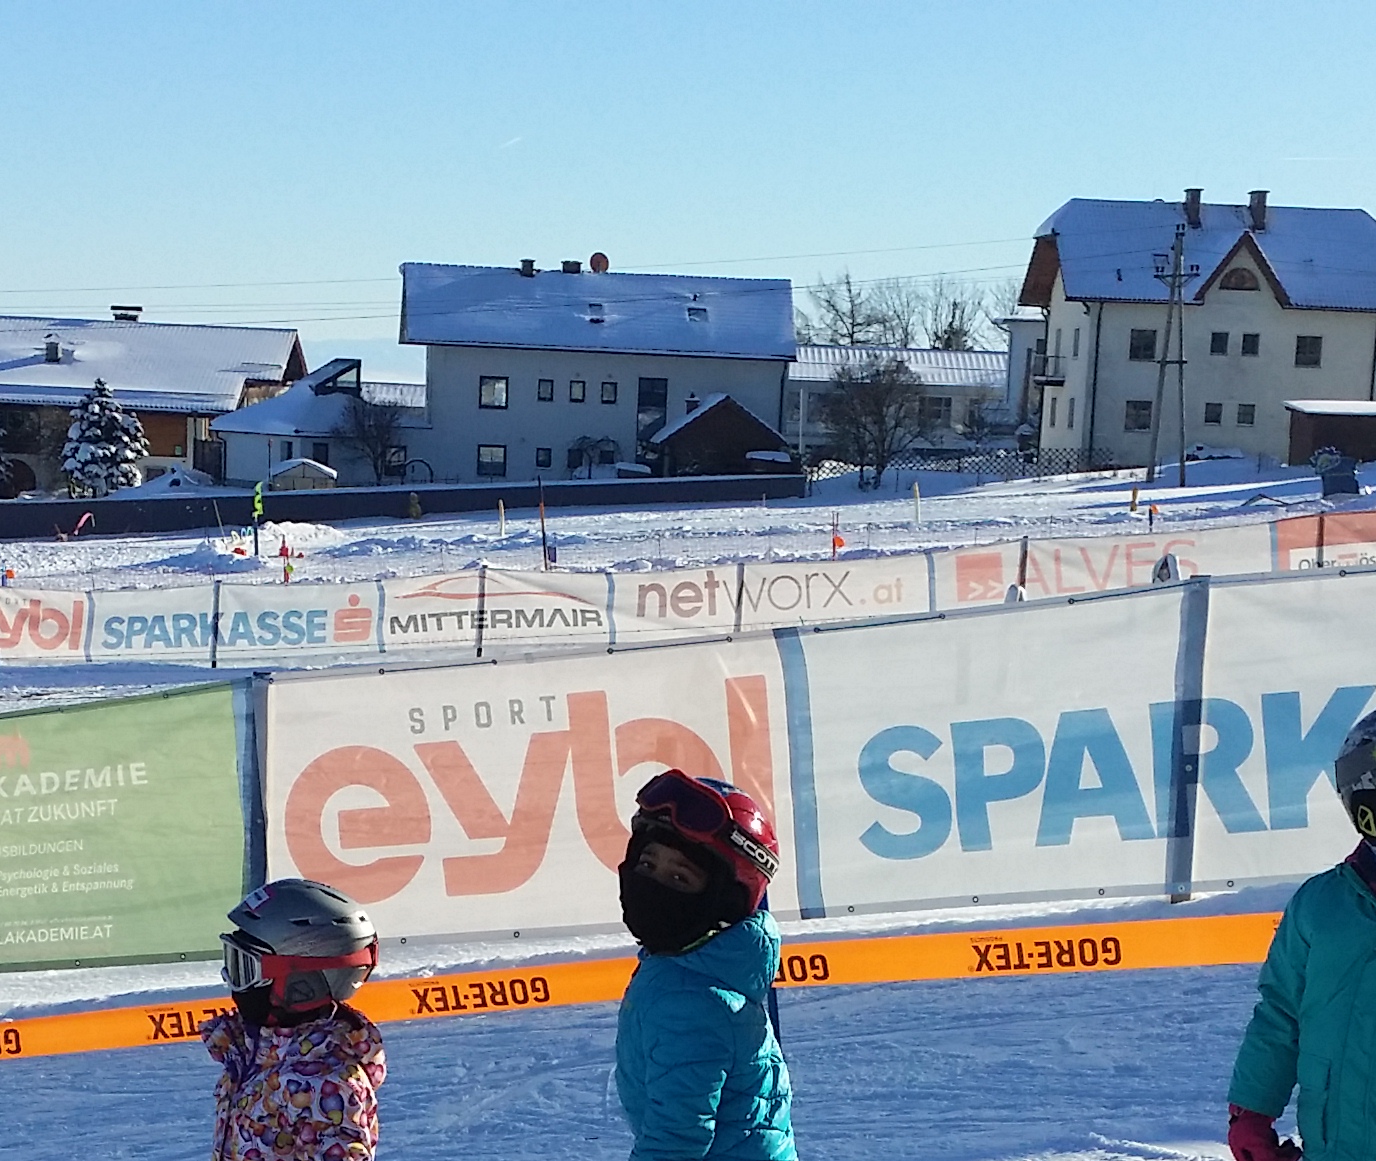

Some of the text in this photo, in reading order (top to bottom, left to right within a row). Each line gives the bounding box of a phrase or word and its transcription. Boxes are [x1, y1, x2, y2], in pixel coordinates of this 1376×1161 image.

[101, 609, 330, 650] SPARKASSE
[389, 608, 603, 635] MITTERMAIR
[409, 695, 556, 735] SPORT
[284, 674, 778, 905] eybl
[27, 799, 119, 824] ZUKUNFT
[51, 882, 58, 893] &
[62, 878, 134, 893] Entspannung
[62, 865, 70, 876] &
[73, 861, 119, 875] Soziales
[974, 936, 1122, 972] GORE-TEX
[411, 976, 551, 1014] GORE-TEX
